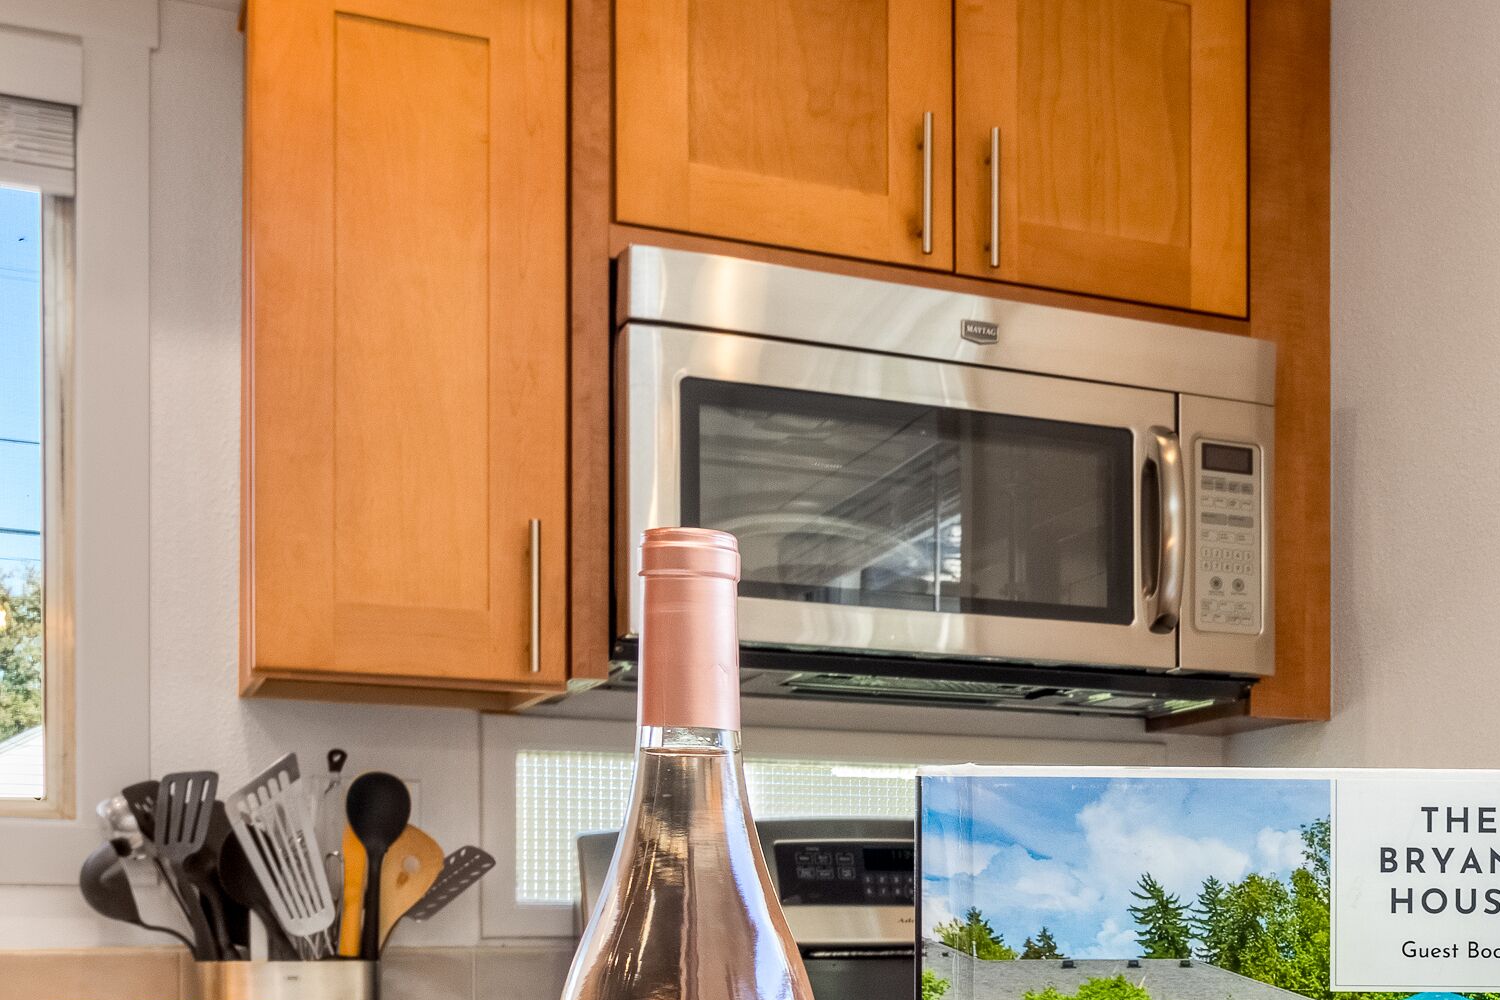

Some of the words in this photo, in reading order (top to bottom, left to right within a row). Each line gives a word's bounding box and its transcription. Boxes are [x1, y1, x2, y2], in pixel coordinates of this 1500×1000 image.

[966, 324, 996, 337] MAYTAG
[1421, 806, 1497, 833] THE
[1401, 940, 1459, 959] Guest
